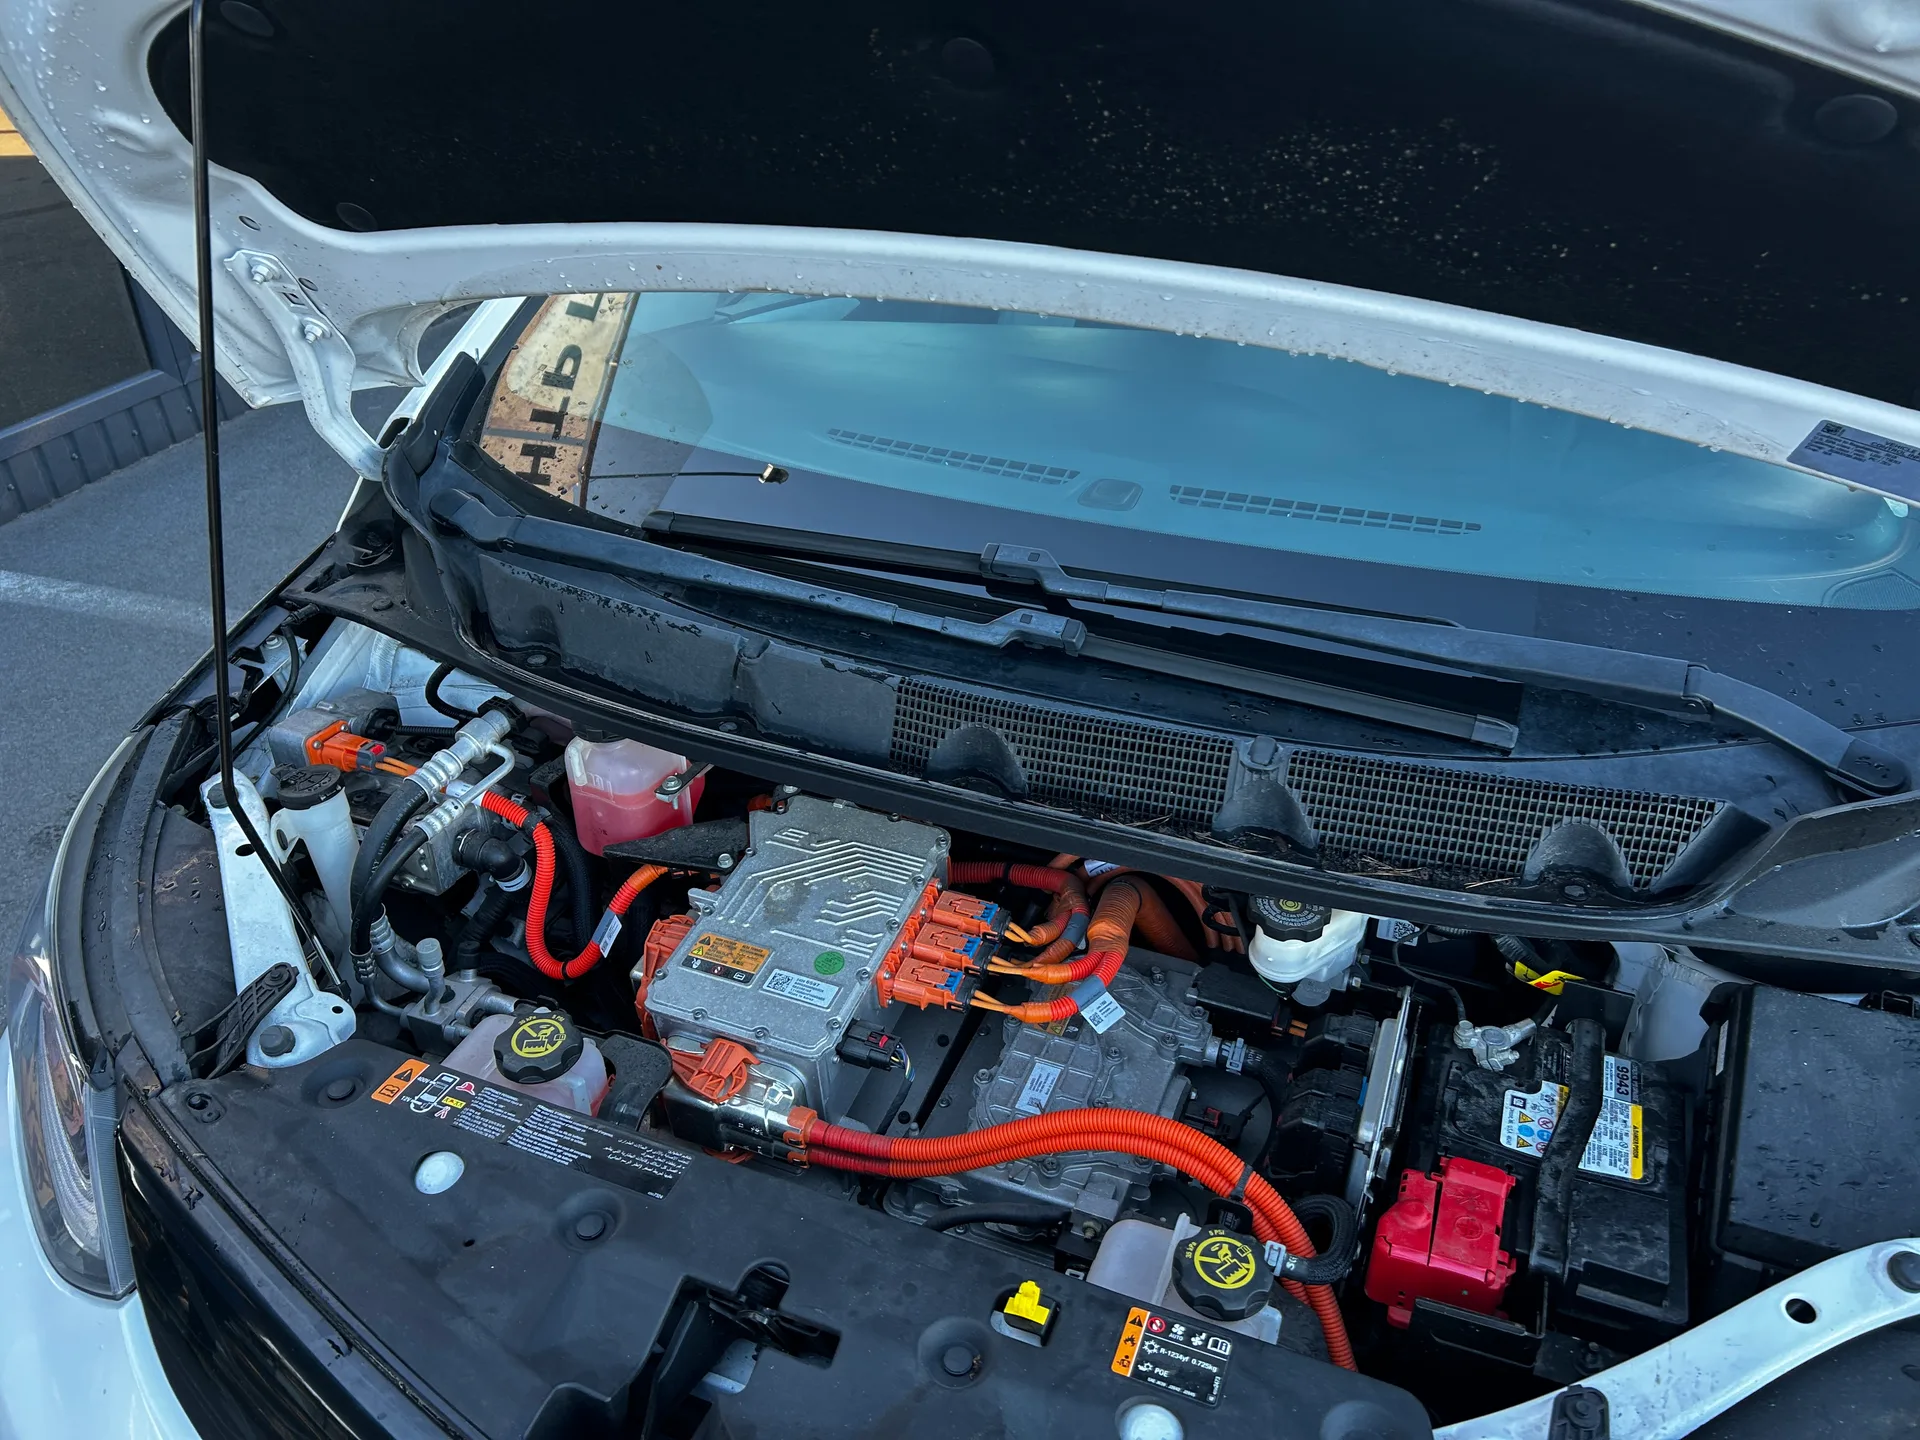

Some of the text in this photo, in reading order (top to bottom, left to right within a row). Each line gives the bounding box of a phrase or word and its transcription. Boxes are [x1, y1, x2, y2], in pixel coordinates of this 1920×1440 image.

[1615, 1065, 1629, 1096] 9943
[1160, 1348, 1218, 1372] R-1234yf 0.725kg
[1154, 1367, 1169, 1378] POE
